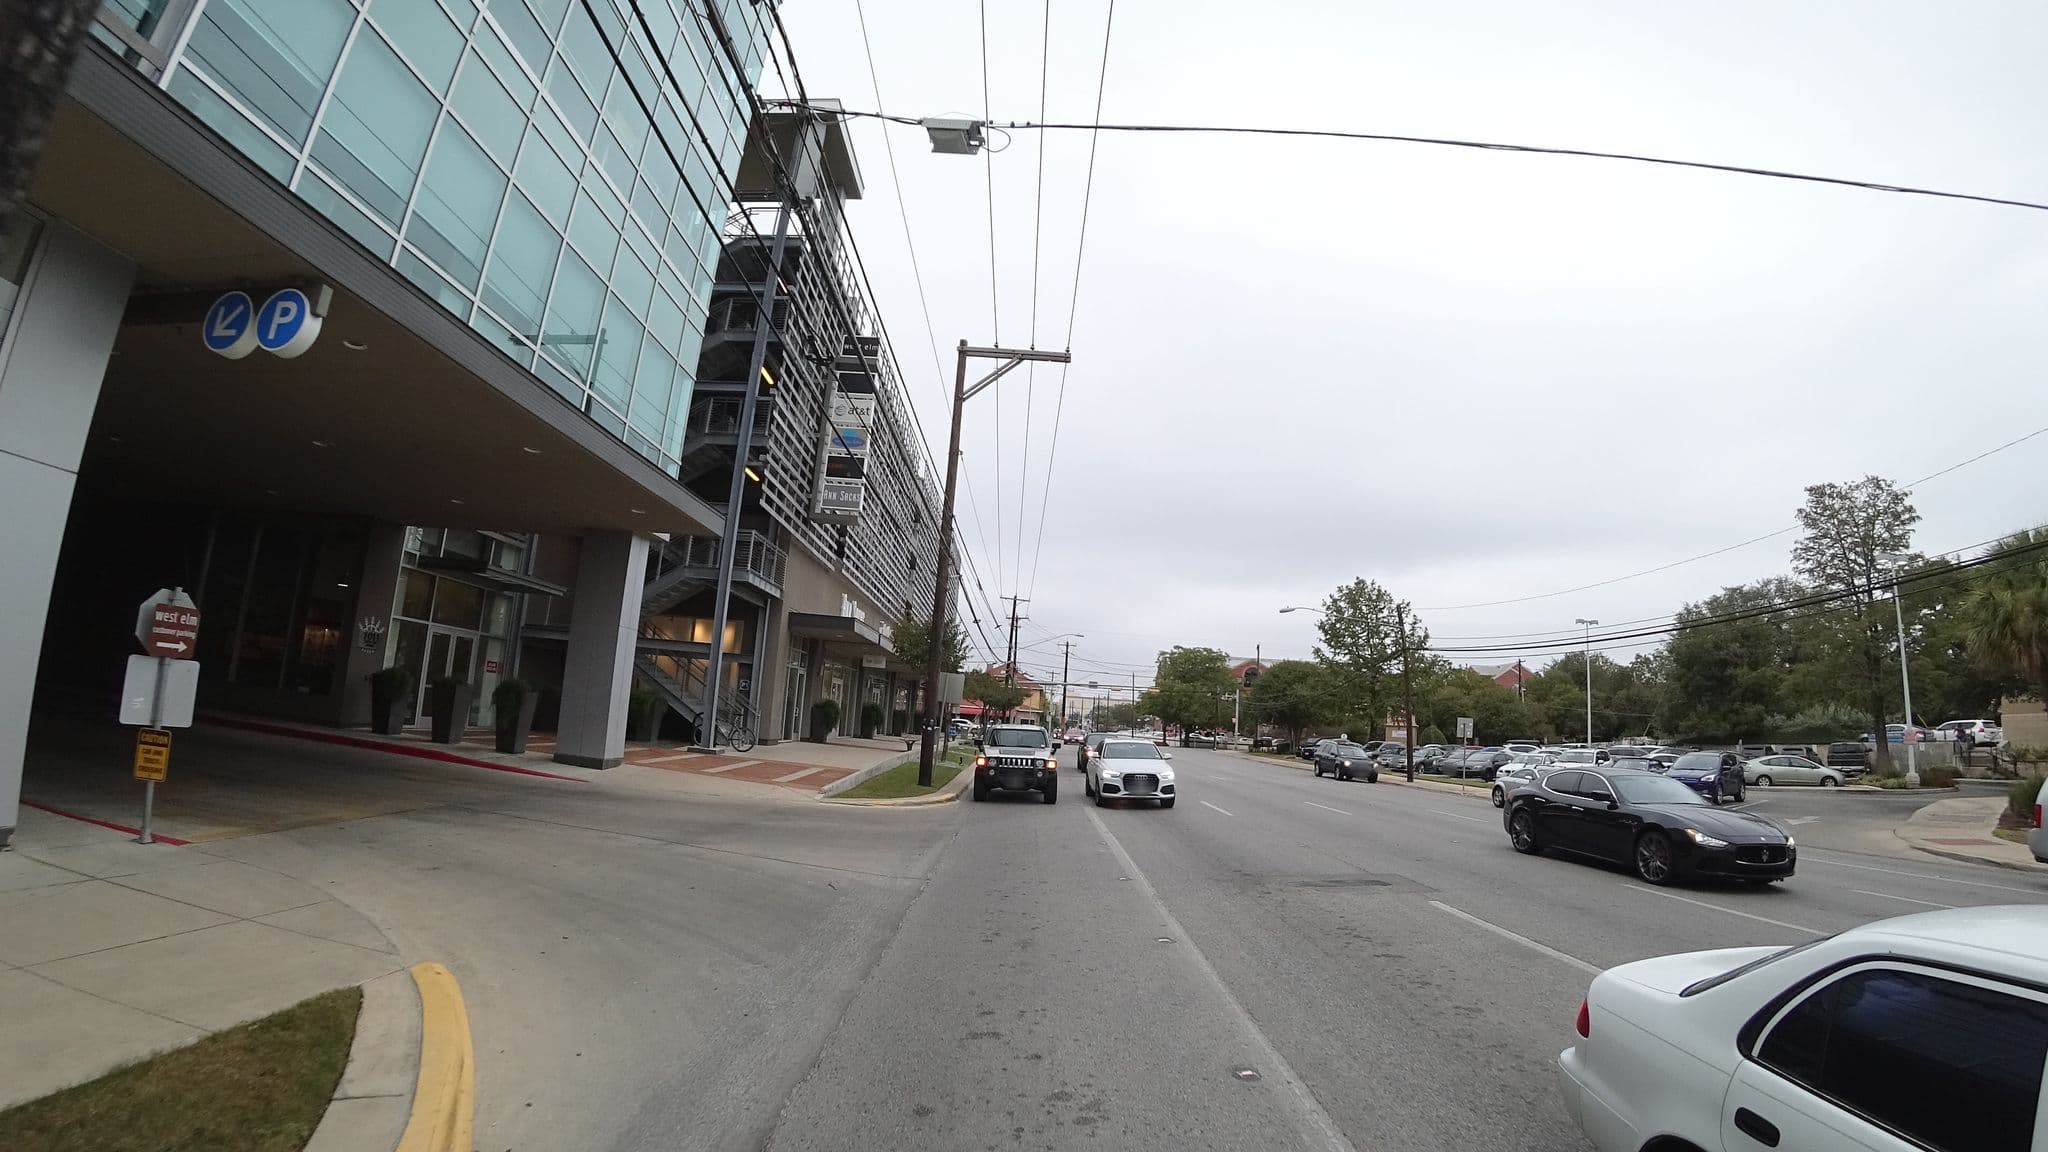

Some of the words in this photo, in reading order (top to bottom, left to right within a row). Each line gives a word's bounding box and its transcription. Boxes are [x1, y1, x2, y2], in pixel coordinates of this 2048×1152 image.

[267, 301, 298, 340] P
[155, 611, 178, 623] west
[180, 613, 198, 626] elm
